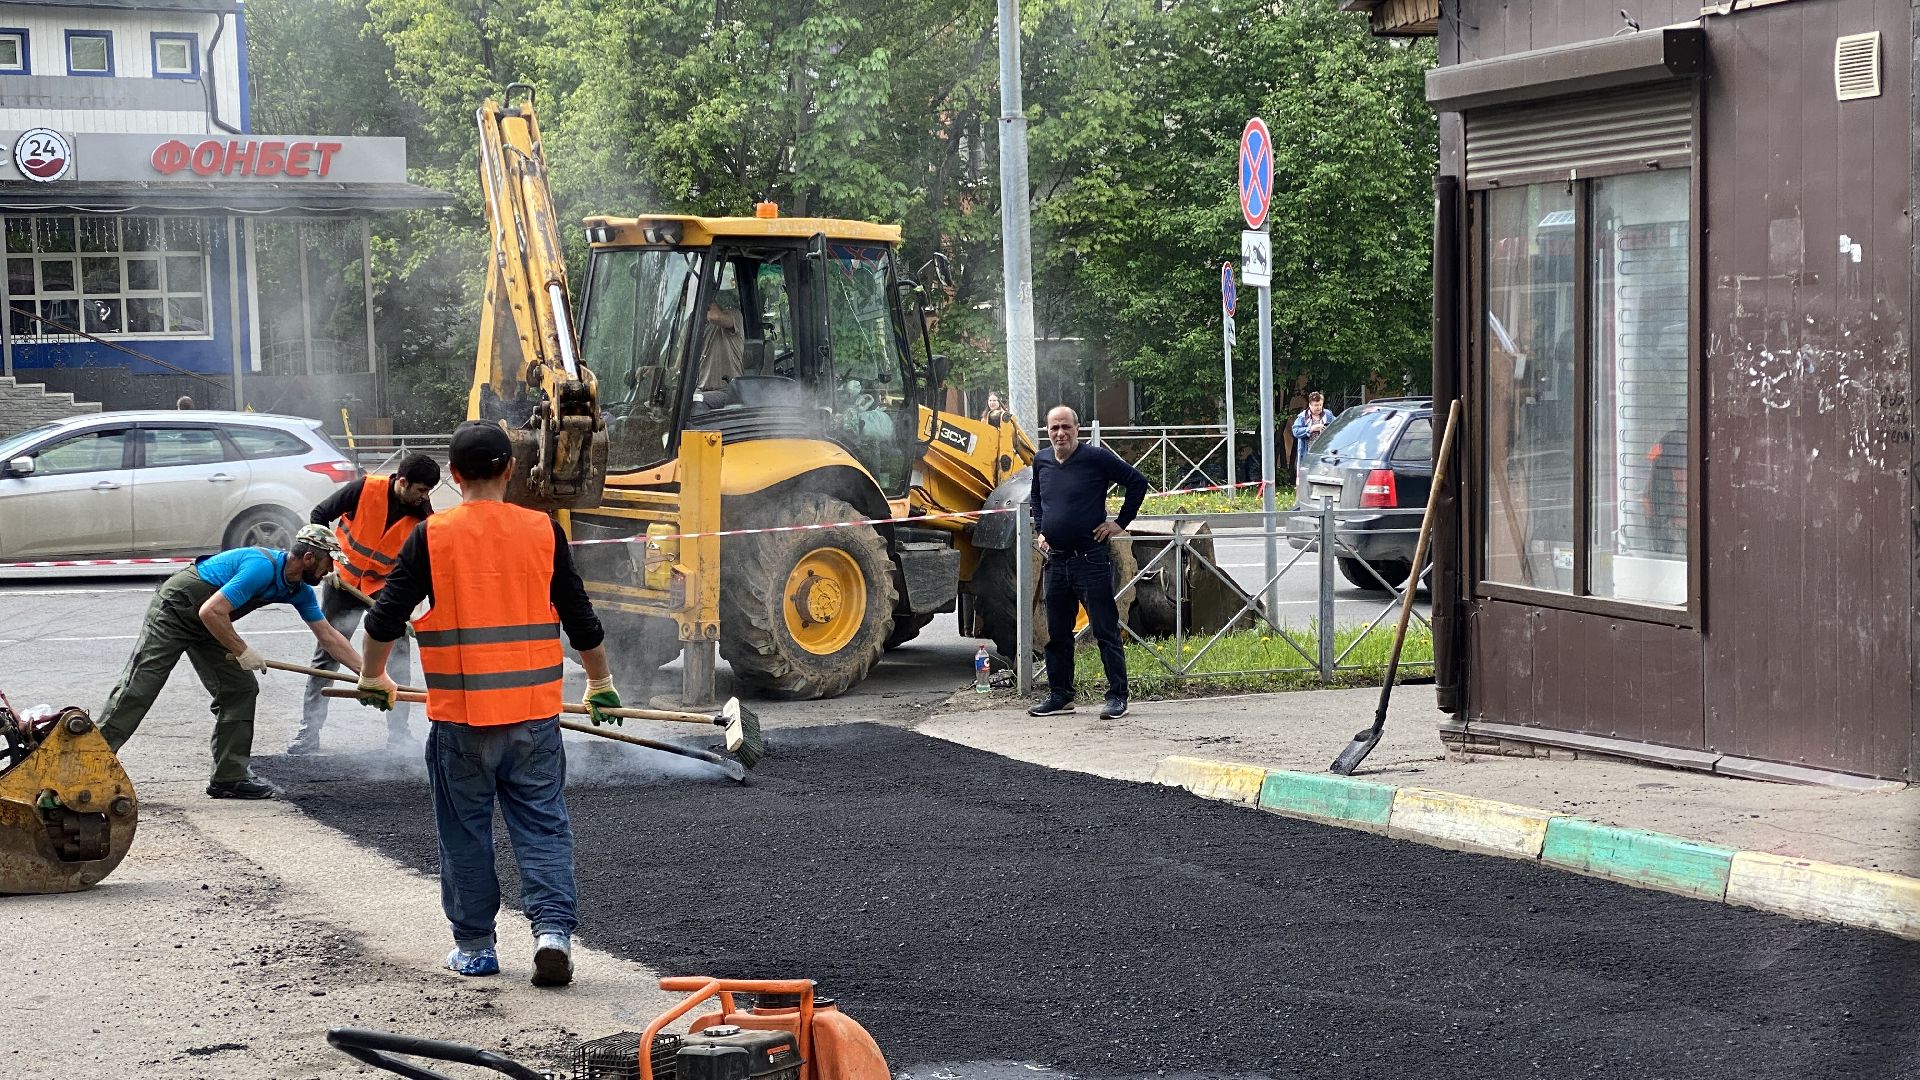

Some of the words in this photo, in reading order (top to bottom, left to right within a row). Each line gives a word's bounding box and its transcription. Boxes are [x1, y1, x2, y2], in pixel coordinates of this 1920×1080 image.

[30, 140, 56, 156] 24
[151, 140, 342, 176] ФОНБЕТ
[940, 427, 967, 447] 3CX
